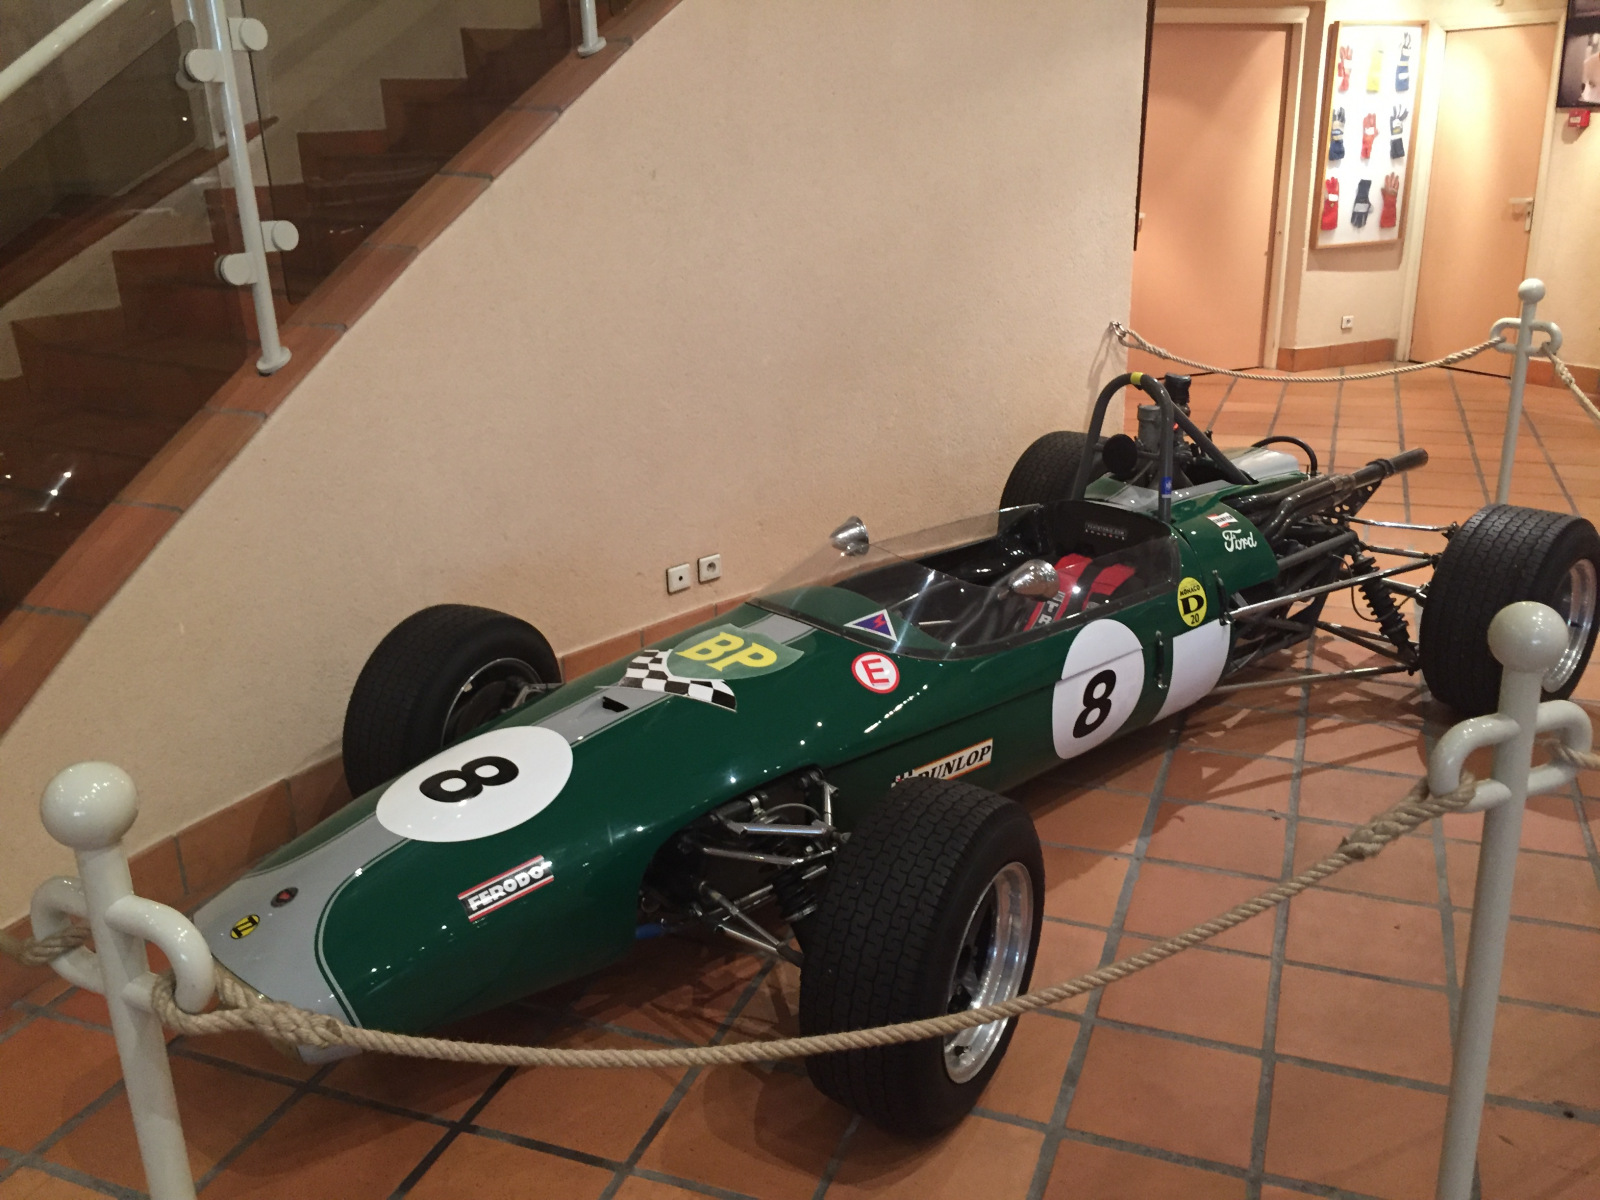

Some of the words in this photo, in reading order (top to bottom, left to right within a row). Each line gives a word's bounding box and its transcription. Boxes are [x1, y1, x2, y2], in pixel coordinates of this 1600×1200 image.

[1222, 529, 1258, 552] Ford
[1179, 584, 1201, 597] MONACO
[1180, 595, 1205, 616] D
[1190, 613, 1200, 625] 20
[675, 632, 778, 672] BP
[861, 658, 890, 685] E
[1072, 669, 1117, 739] 8
[419, 755, 520, 803] 8
[467, 865, 545, 911] FERODO
